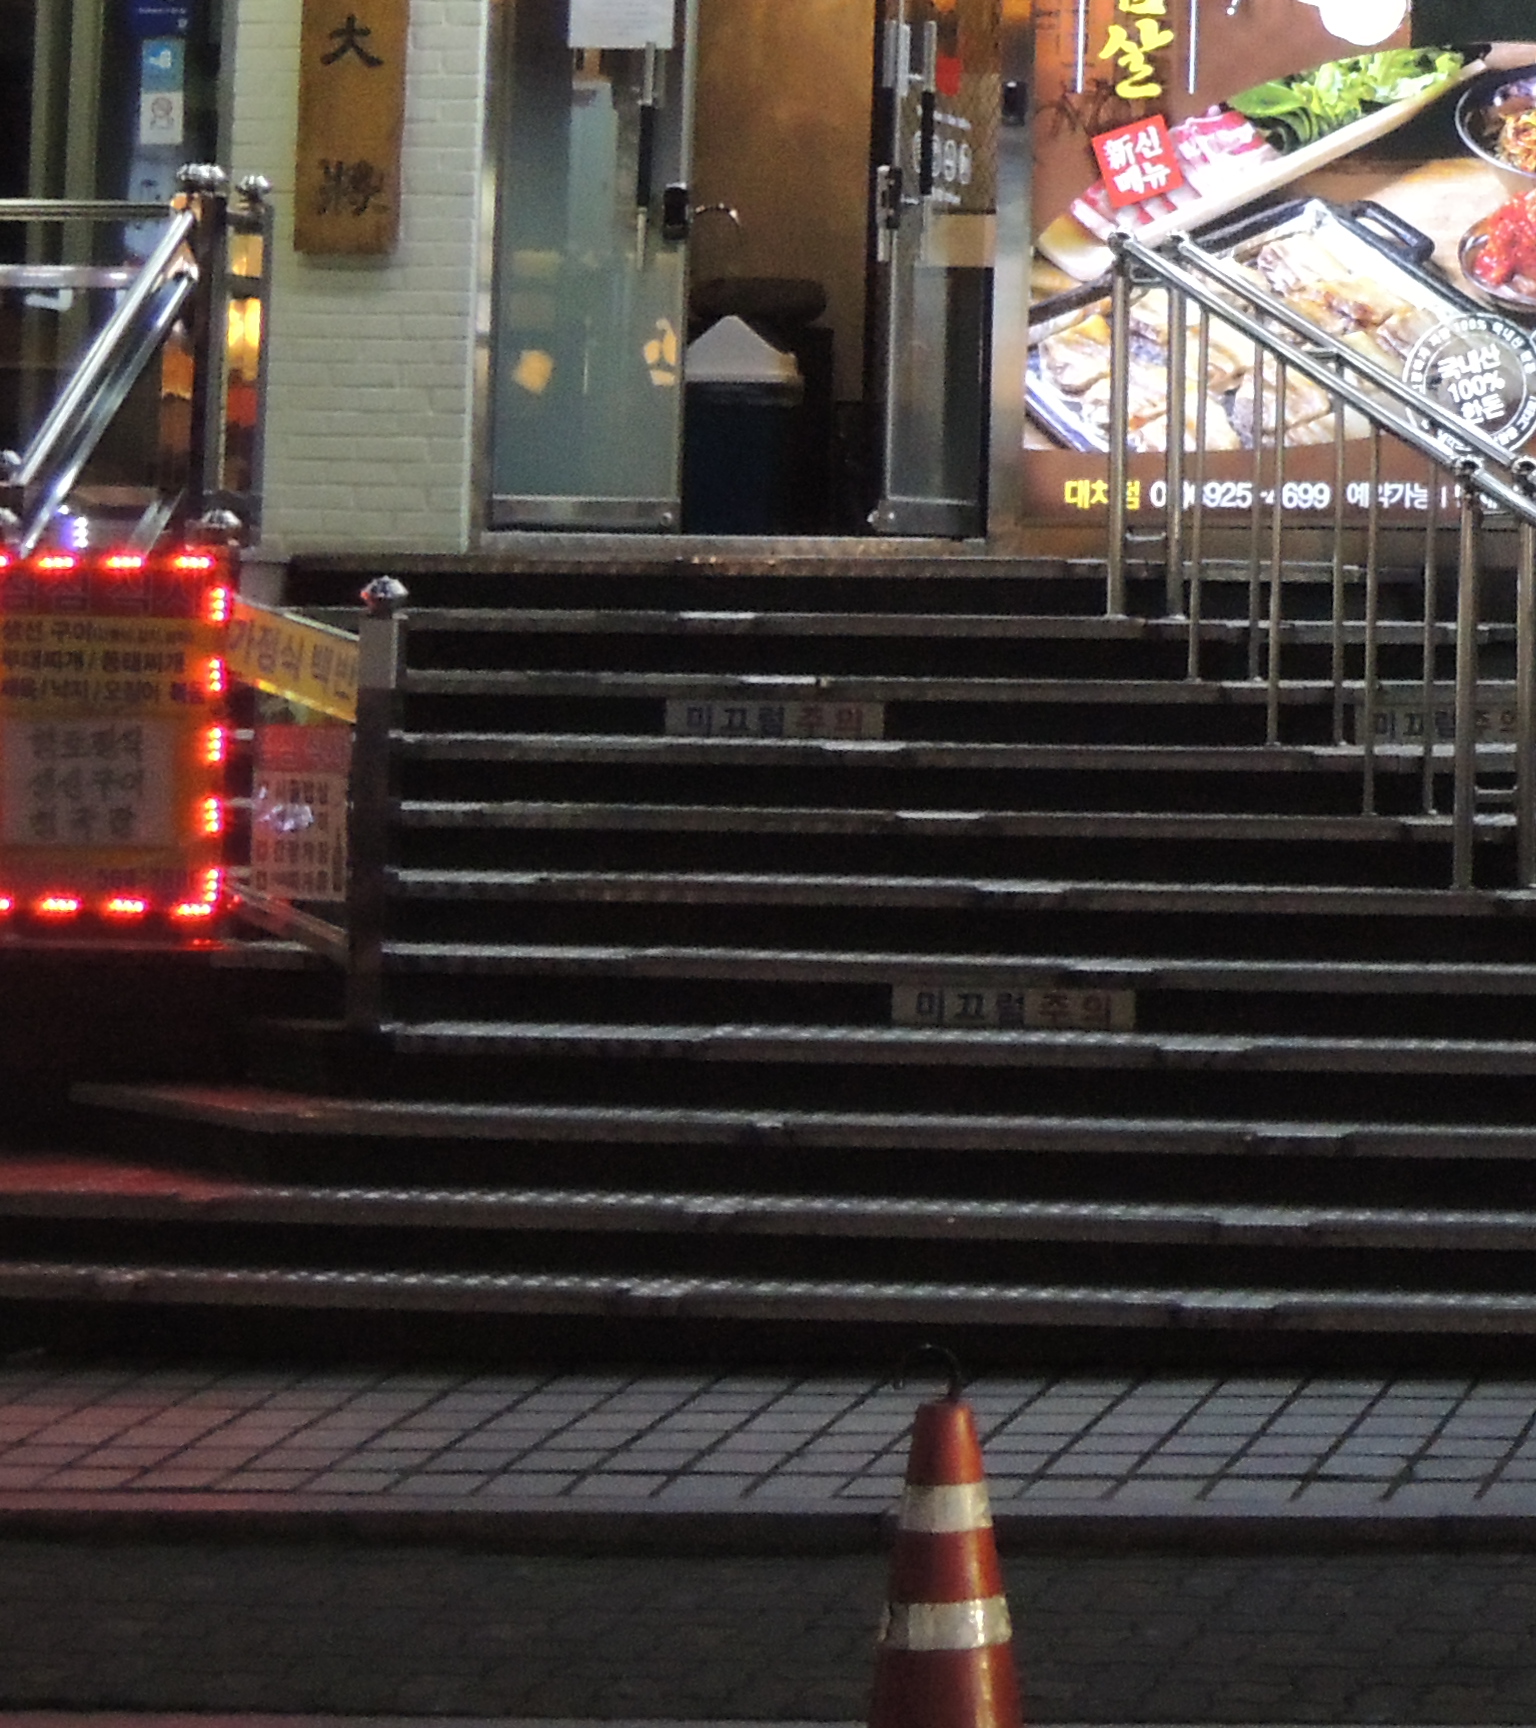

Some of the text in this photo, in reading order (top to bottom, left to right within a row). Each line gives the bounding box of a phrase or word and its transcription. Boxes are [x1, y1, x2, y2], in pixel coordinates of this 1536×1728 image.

[1437, 343, 1501, 380] 국내산
[1447, 369, 1506, 403] 100%
[686, 706, 864, 737] 미끄럼 주의
[916, 989, 1112, 1032] 미끄럼 주의
